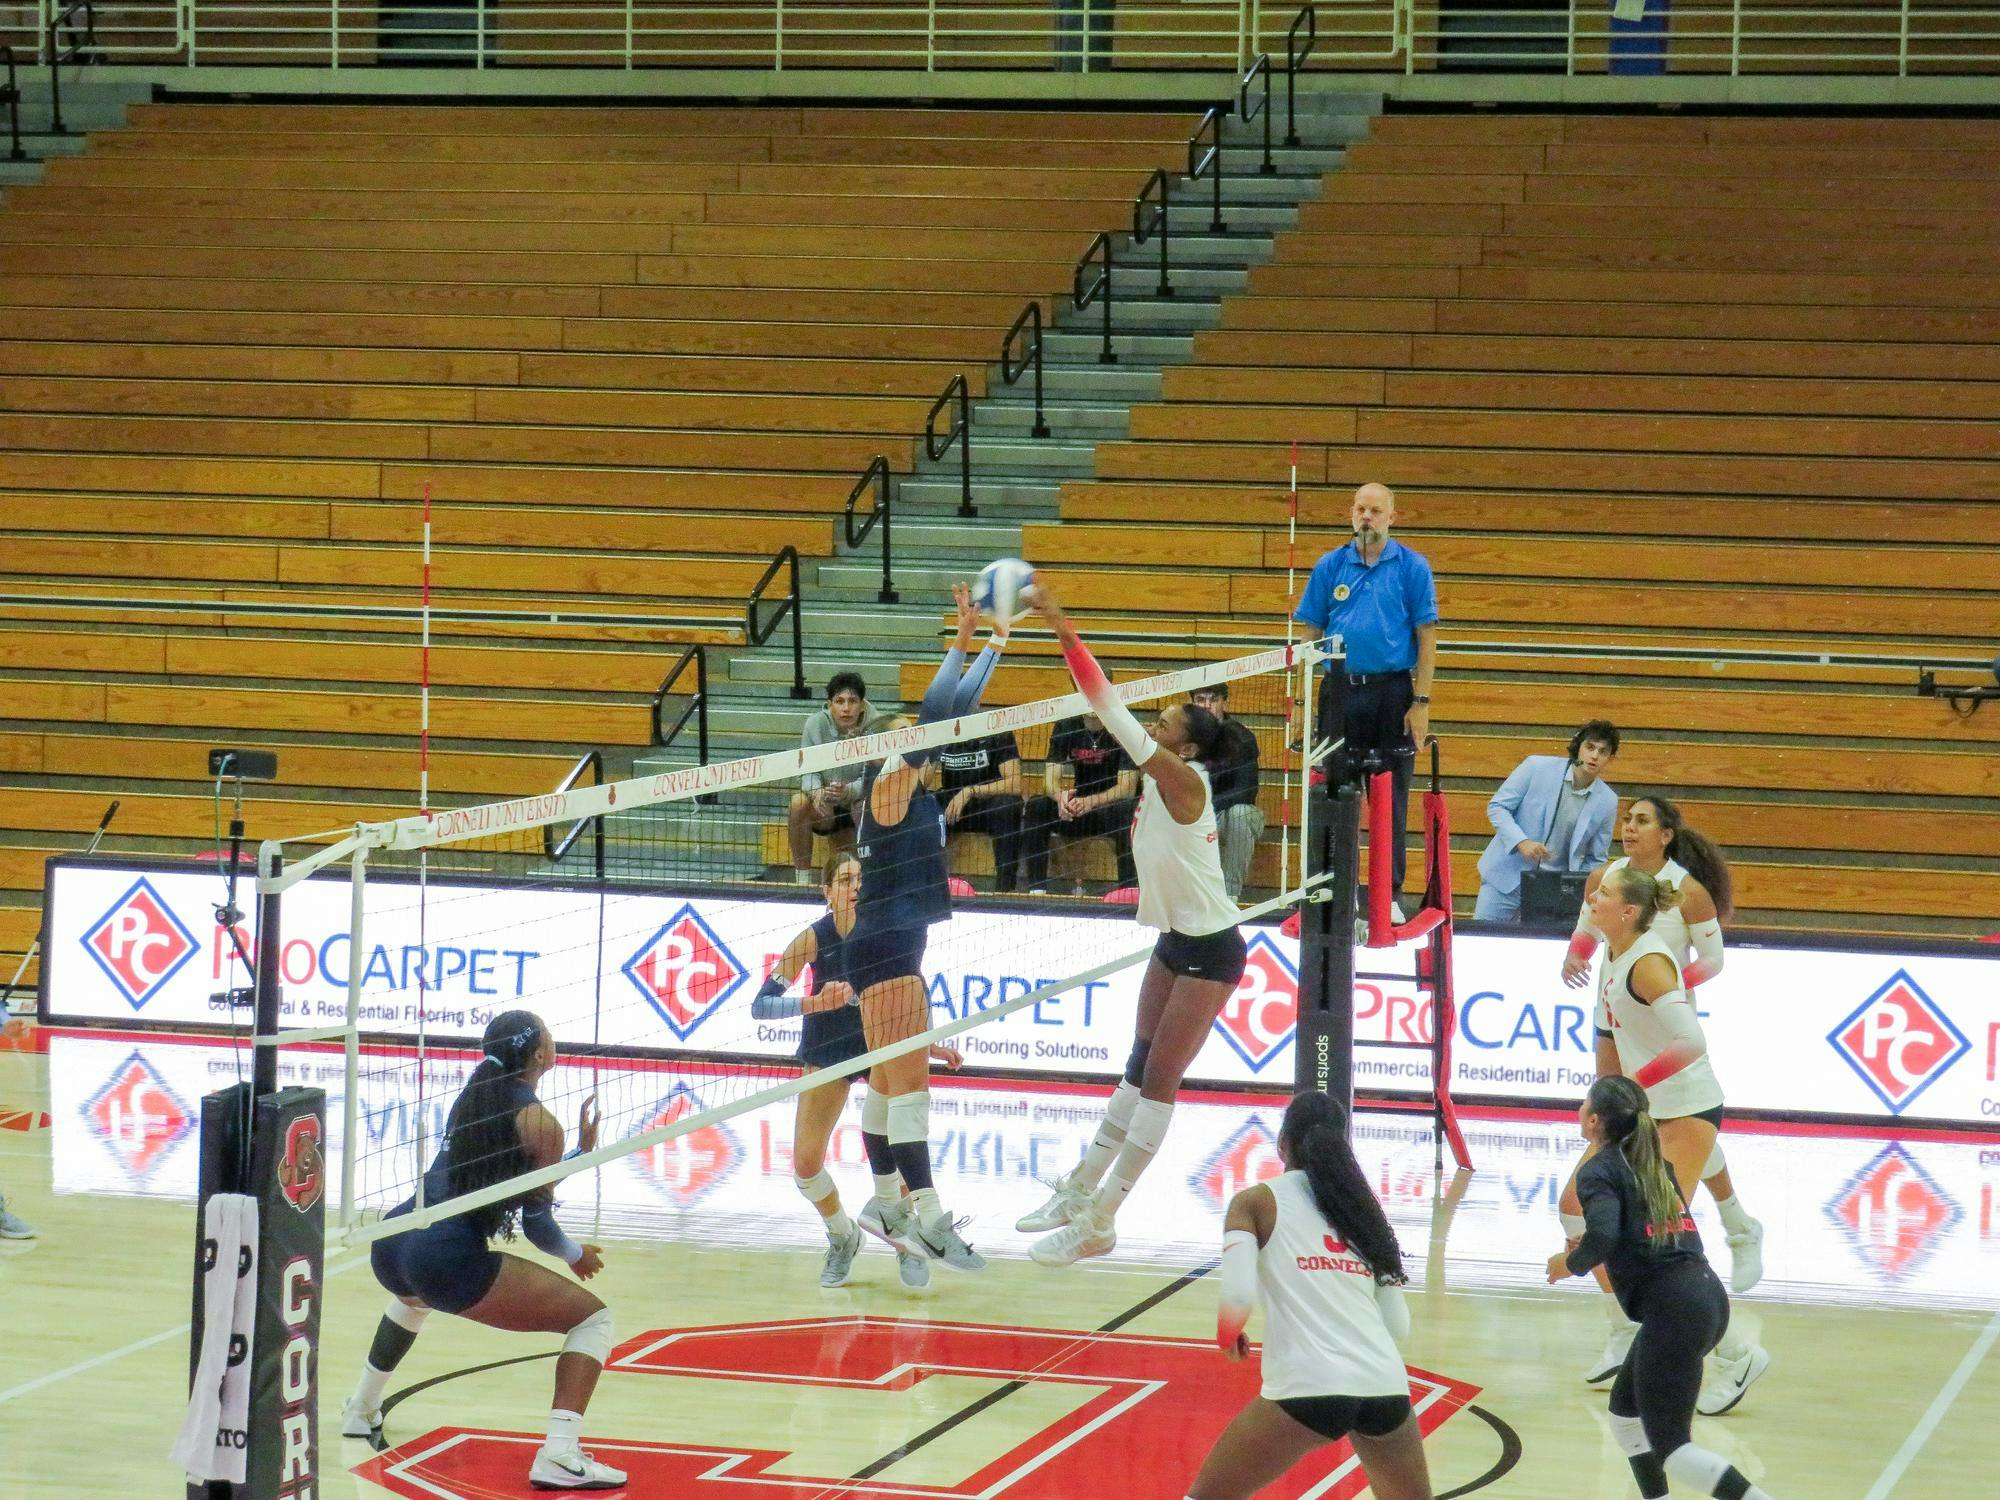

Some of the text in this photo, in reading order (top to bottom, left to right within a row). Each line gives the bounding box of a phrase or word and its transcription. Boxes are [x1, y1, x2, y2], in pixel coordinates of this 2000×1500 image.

[110, 908, 170, 985] PC
[212, 924, 541, 995] POCARPET
[655, 935, 716, 1014] PC
[301, 1000, 311, 1015] &
[965, 1036, 1029, 1060] Flooring
[1035, 1040, 1109, 1061] Solutions
[1315, 1034, 1330, 1078] sports
[1863, 1002, 1935, 1087] PC
[1458, 1063, 1551, 1084] Residential
